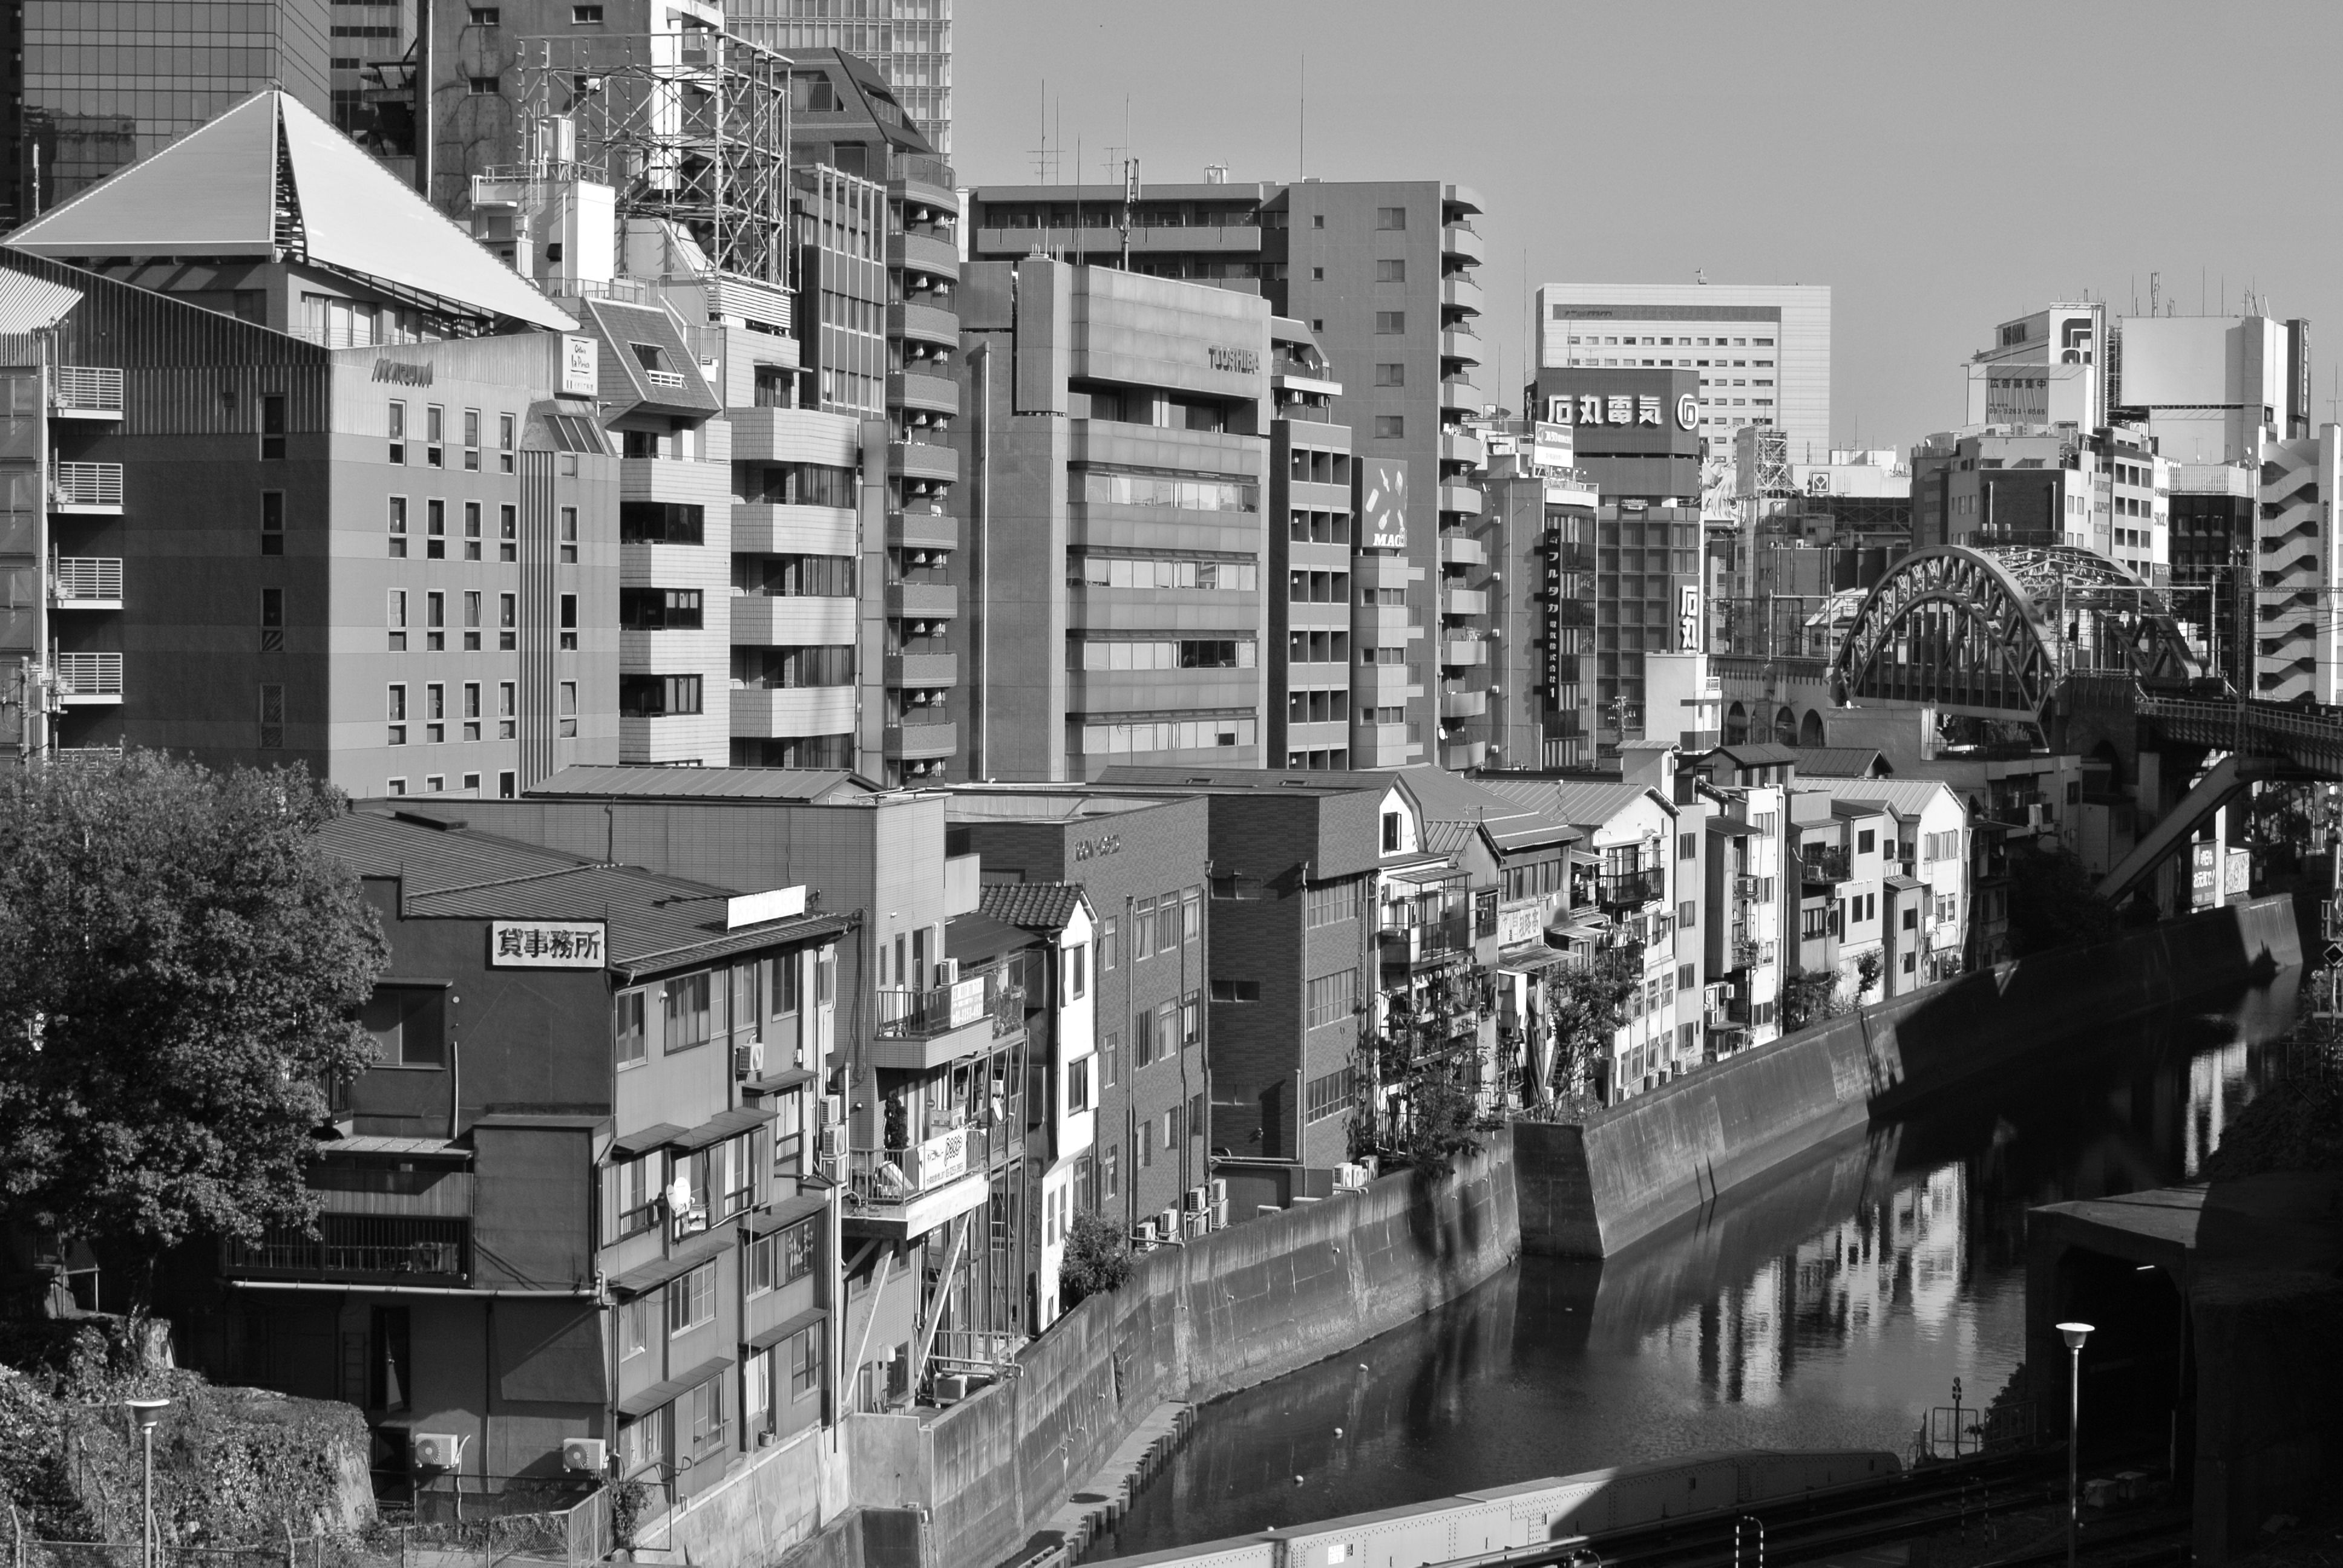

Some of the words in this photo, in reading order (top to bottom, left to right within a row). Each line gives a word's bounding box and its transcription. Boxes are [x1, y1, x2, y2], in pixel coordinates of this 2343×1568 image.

[1209, 345, 1260, 373] TOSHIBA
[1989, 378, 2046, 389] 広告募集中
[1547, 394, 1663, 425] 石丸電気
[497, 928, 601, 959] 貸事務所
